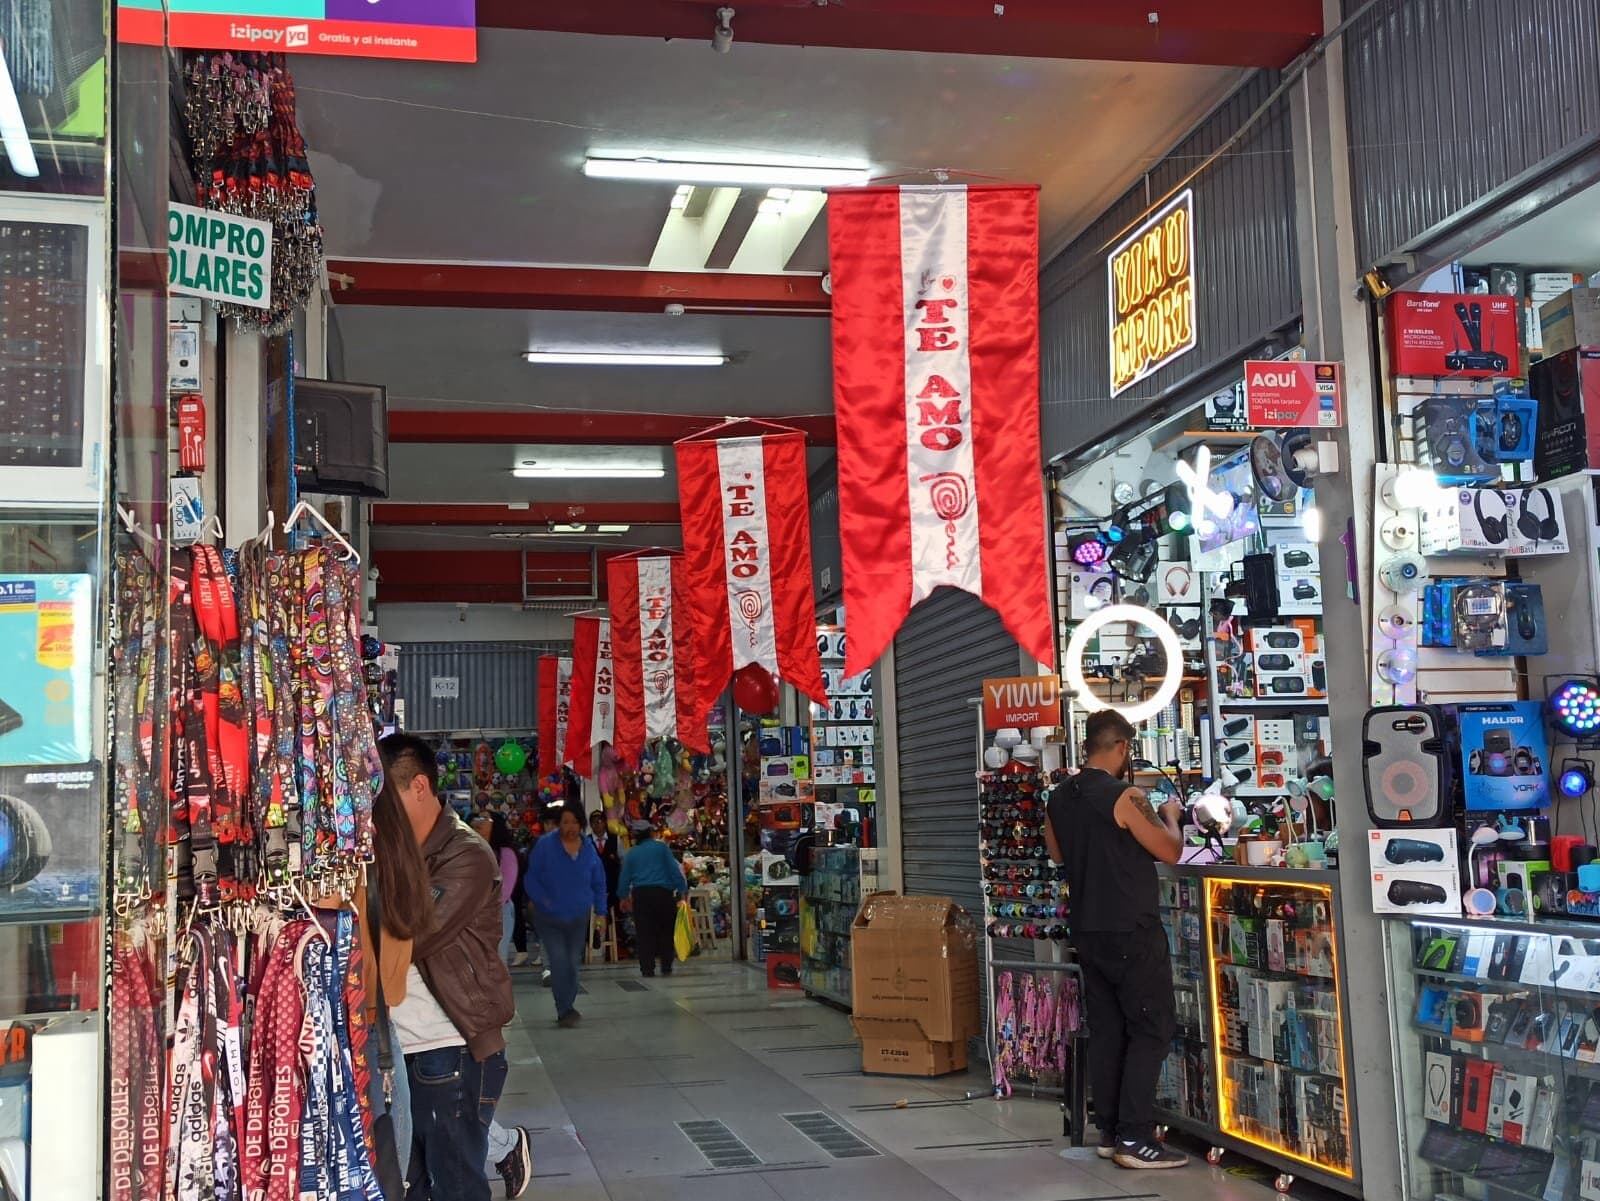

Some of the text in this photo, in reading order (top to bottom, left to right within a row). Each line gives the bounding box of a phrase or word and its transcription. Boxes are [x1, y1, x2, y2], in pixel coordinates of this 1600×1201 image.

[230, 23, 307, 44] izipay ya
[318, 33, 351, 43] Gratis
[353, 36, 360, 45] y
[374, 36, 418, 47] instante
[1491, 301, 1508, 310] UHF
[915, 299, 959, 352] TE
[1251, 370, 1297, 388] AQUÍ
[916, 374, 964, 451] AMO
[1264, 408, 1300, 421] izipay
[727, 484, 755, 518] TE
[730, 530, 758, 578] AMO
[646, 596, 666, 620] TE
[648, 628, 668, 663] AMO
[435, 681, 456, 690] K-12
[597, 666, 612, 696] AMO
[989, 683, 1055, 710] YIWU
[1005, 712, 1039, 723] IMPORT
[1482, 716, 1524, 725] HALION
[1512, 783, 1539, 792] YORK
[188, 1081, 205, 1143] adidas
[246, 1047, 263, 1157] DE DEPORTES
[271, 1064, 291, 1176] DE DEPORTES
[349, 1103, 364, 1149] LIMA
